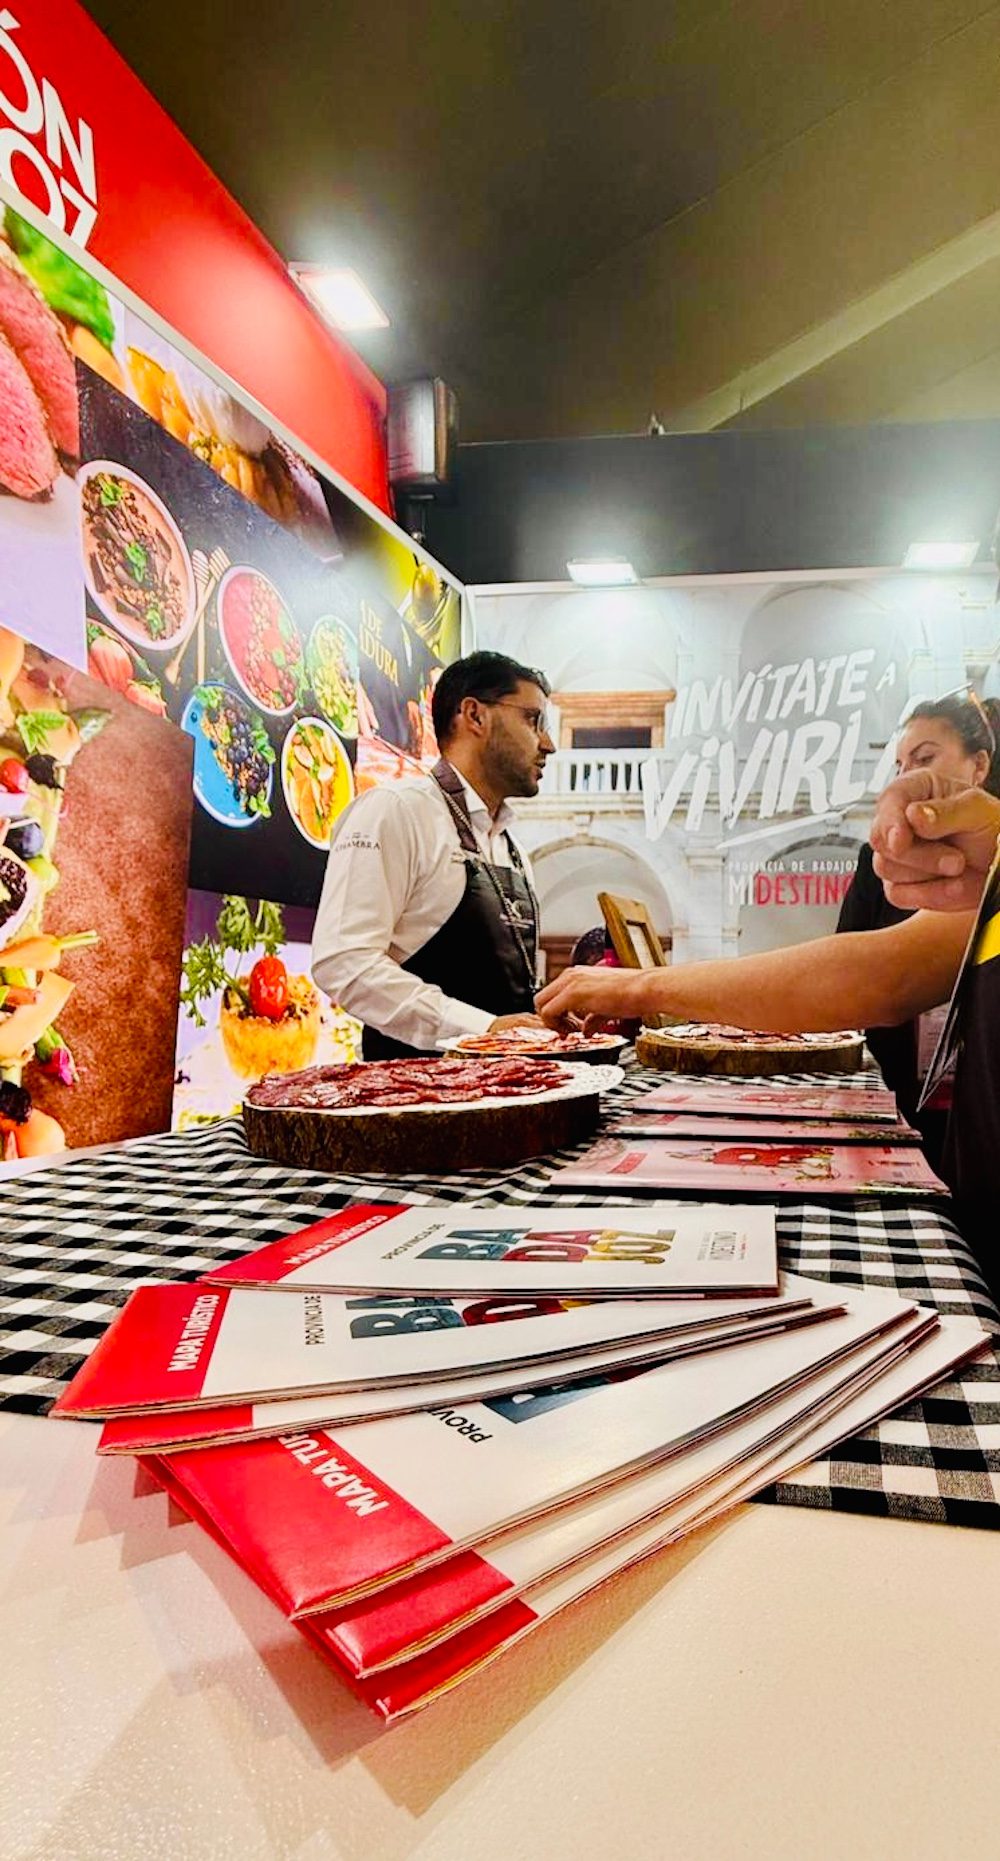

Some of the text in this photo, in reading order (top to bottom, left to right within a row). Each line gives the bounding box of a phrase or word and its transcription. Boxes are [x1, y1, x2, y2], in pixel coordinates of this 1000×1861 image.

[670, 648, 897, 739] INVÍTATE A
[727, 861, 786, 872] PROVINCIA
[791, 860, 806, 872] DE
[380, 1229, 433, 1260] PROVINCIA
[166, 1294, 220, 1372] MAPA TURÍSTICO
[304, 1294, 325, 1346] PROVINCIA DE
[311, 1457, 390, 1517] MAPA
